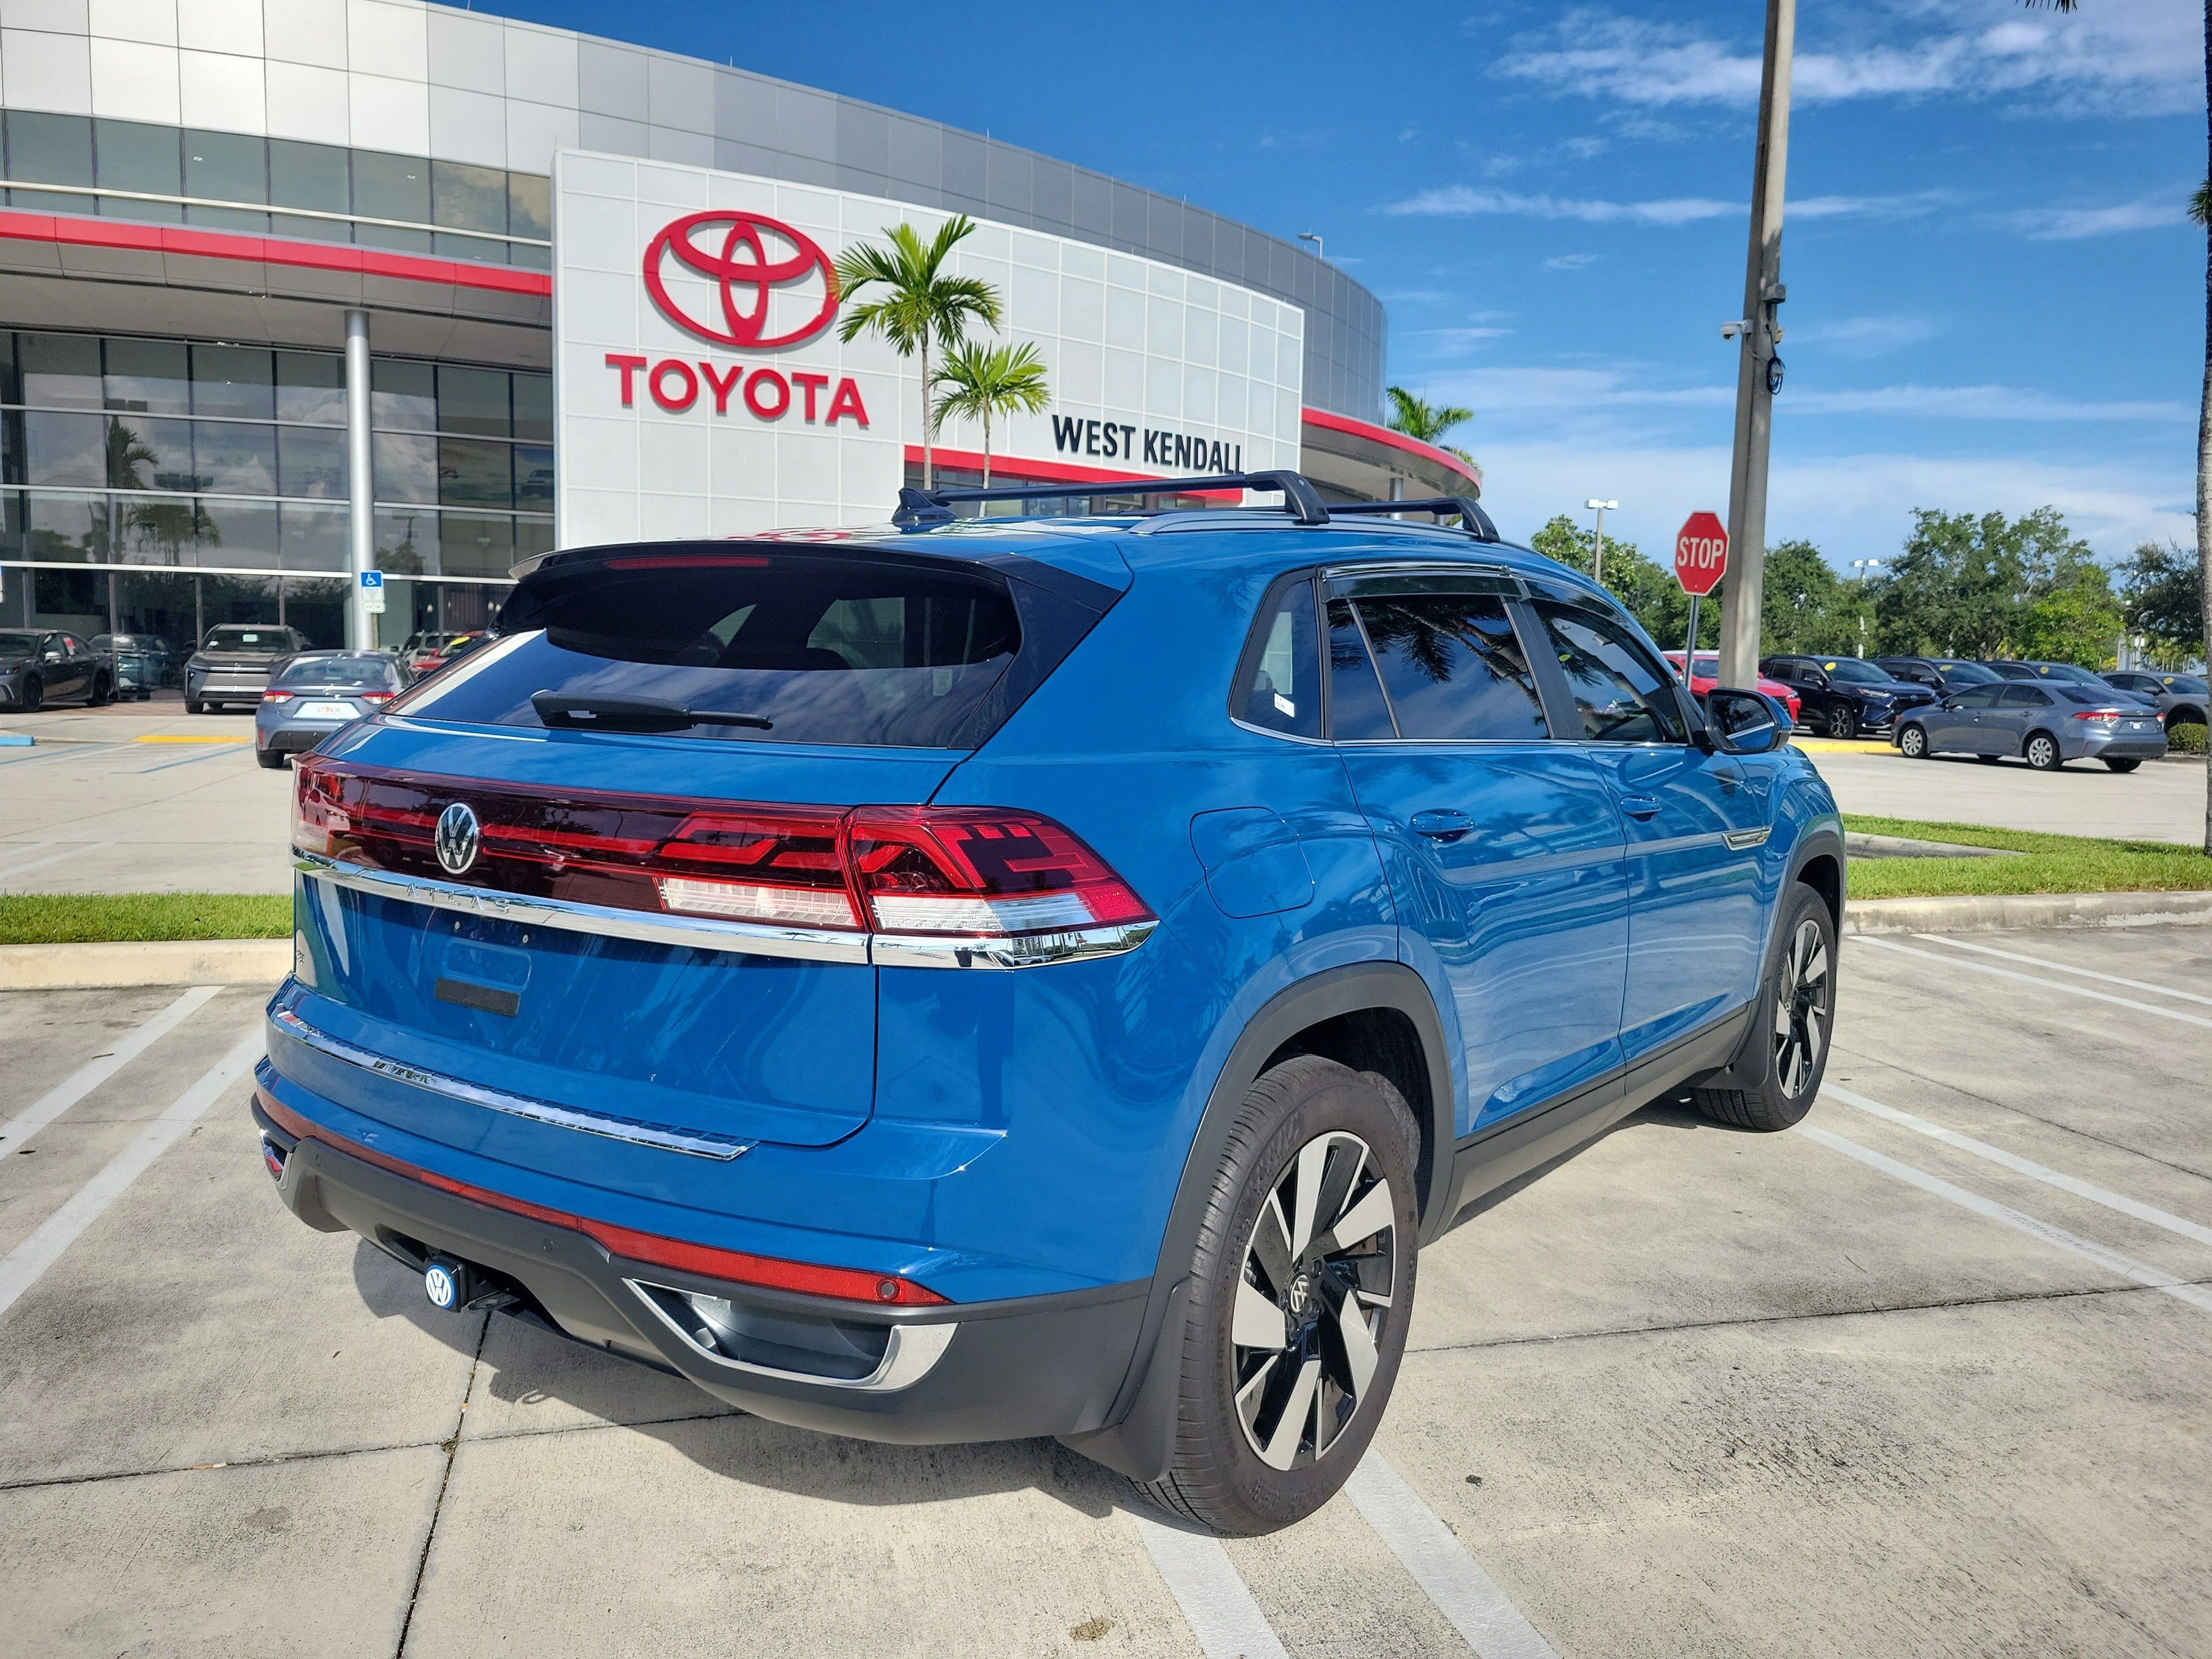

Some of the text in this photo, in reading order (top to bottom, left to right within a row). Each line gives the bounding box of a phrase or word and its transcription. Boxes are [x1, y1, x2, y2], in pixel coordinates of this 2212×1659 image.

[605, 353, 870, 426] TOYOTA
[1052, 415, 1244, 475] WEST KENDALL
[1677, 537, 1724, 569] STOP
[426, 1268, 452, 1306] VW
